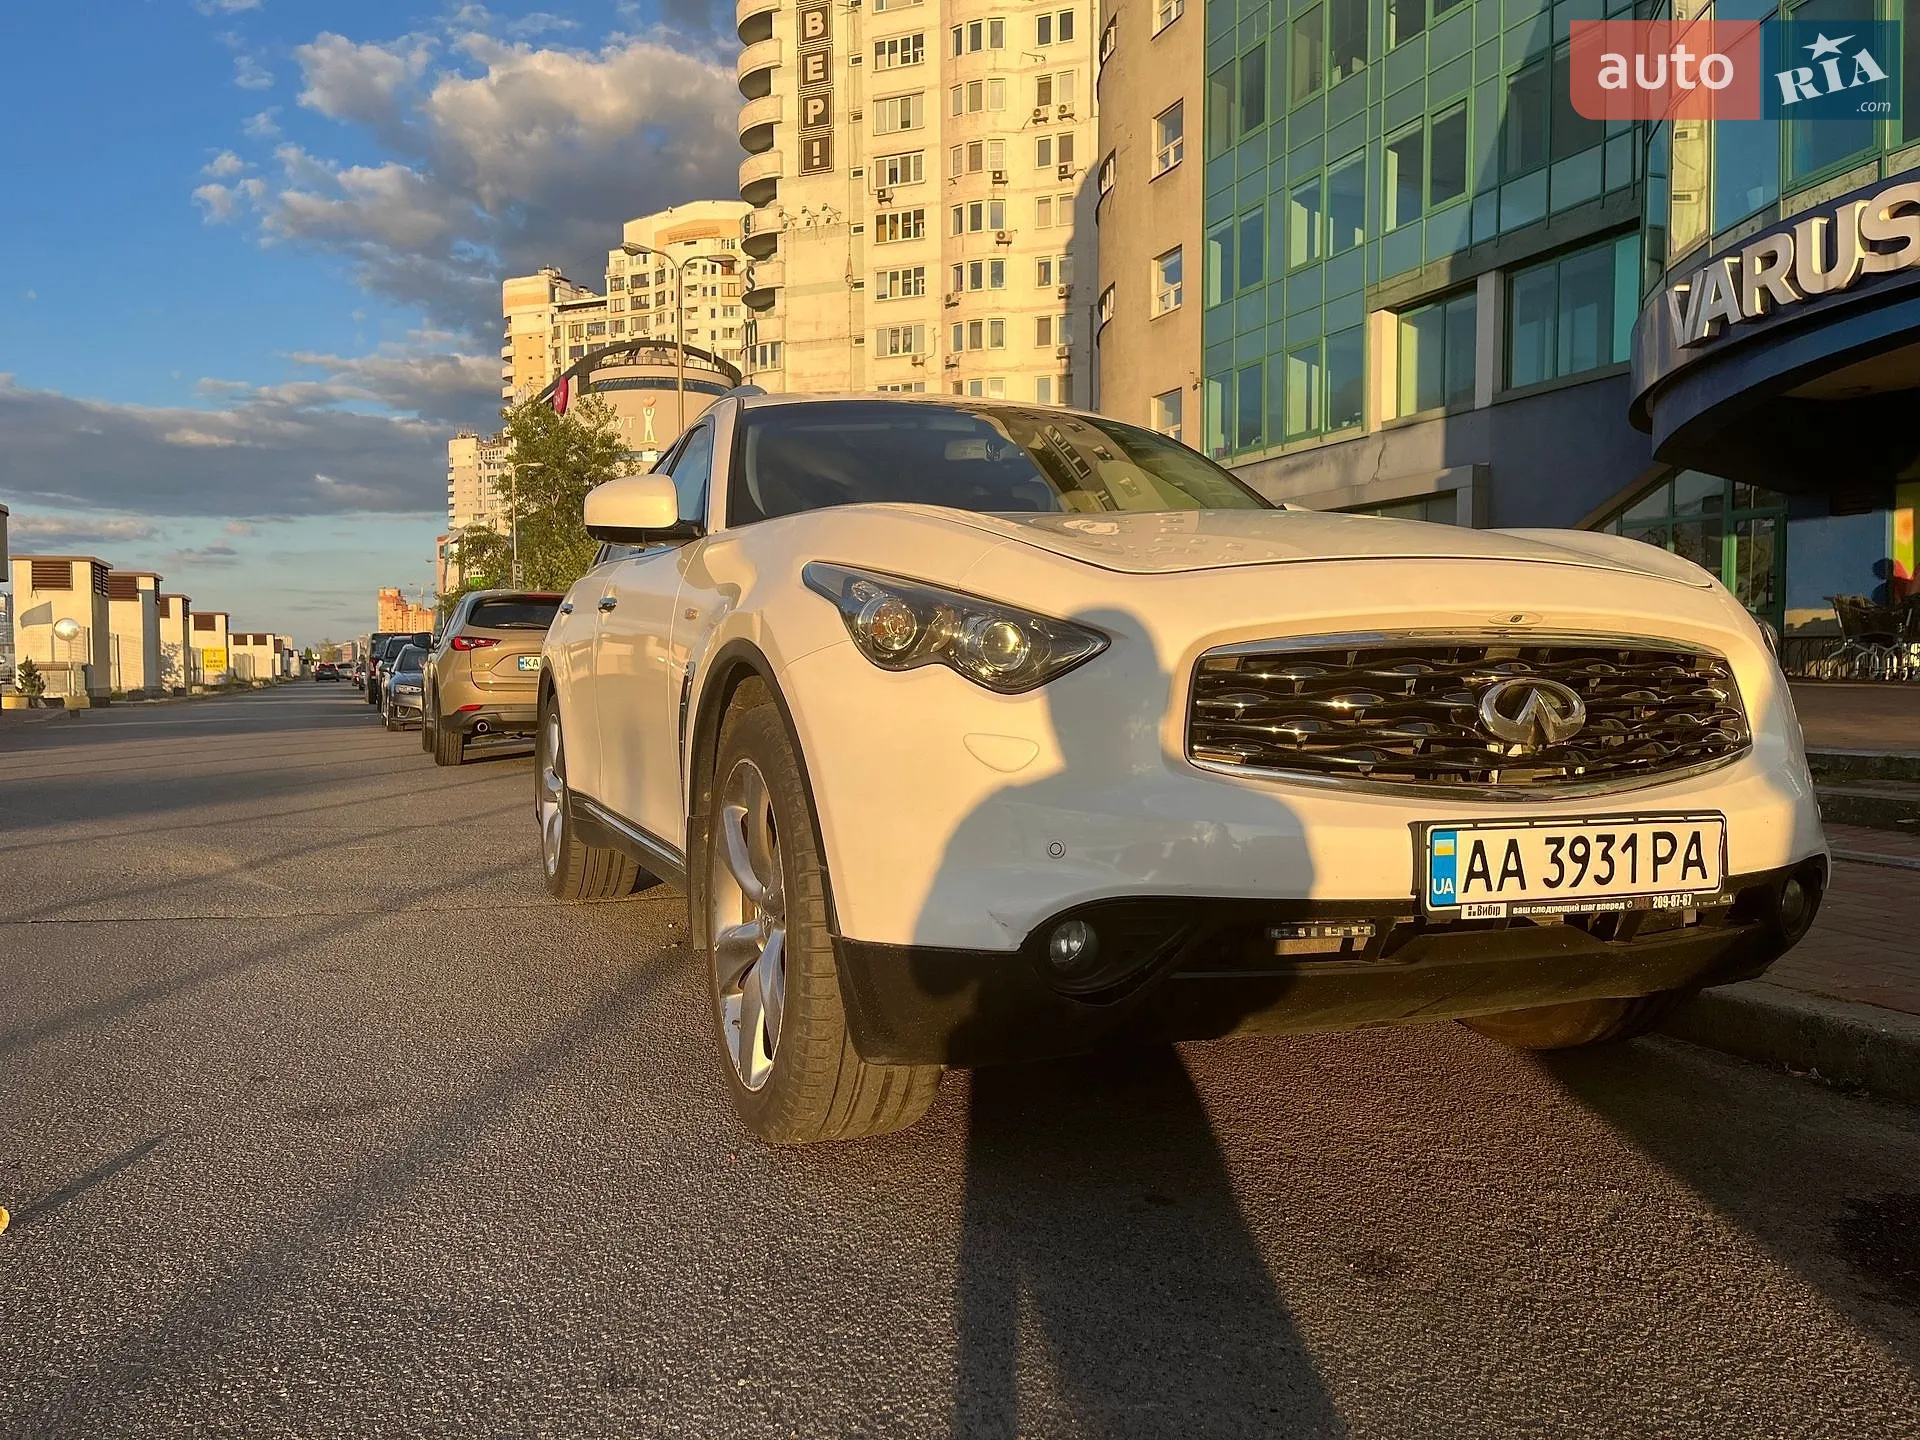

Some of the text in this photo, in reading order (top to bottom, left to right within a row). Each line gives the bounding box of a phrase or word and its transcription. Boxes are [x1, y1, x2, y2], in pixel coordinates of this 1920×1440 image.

[1666, 182, 1920, 349] VARUS
[1462, 830, 1707, 894] AA 3931 PA
[1433, 878, 1454, 894] UA
[1512, 905, 1530, 915] ваш
[1531, 903, 1580, 915] следующий
[1581, 902, 1595, 912] шаг
